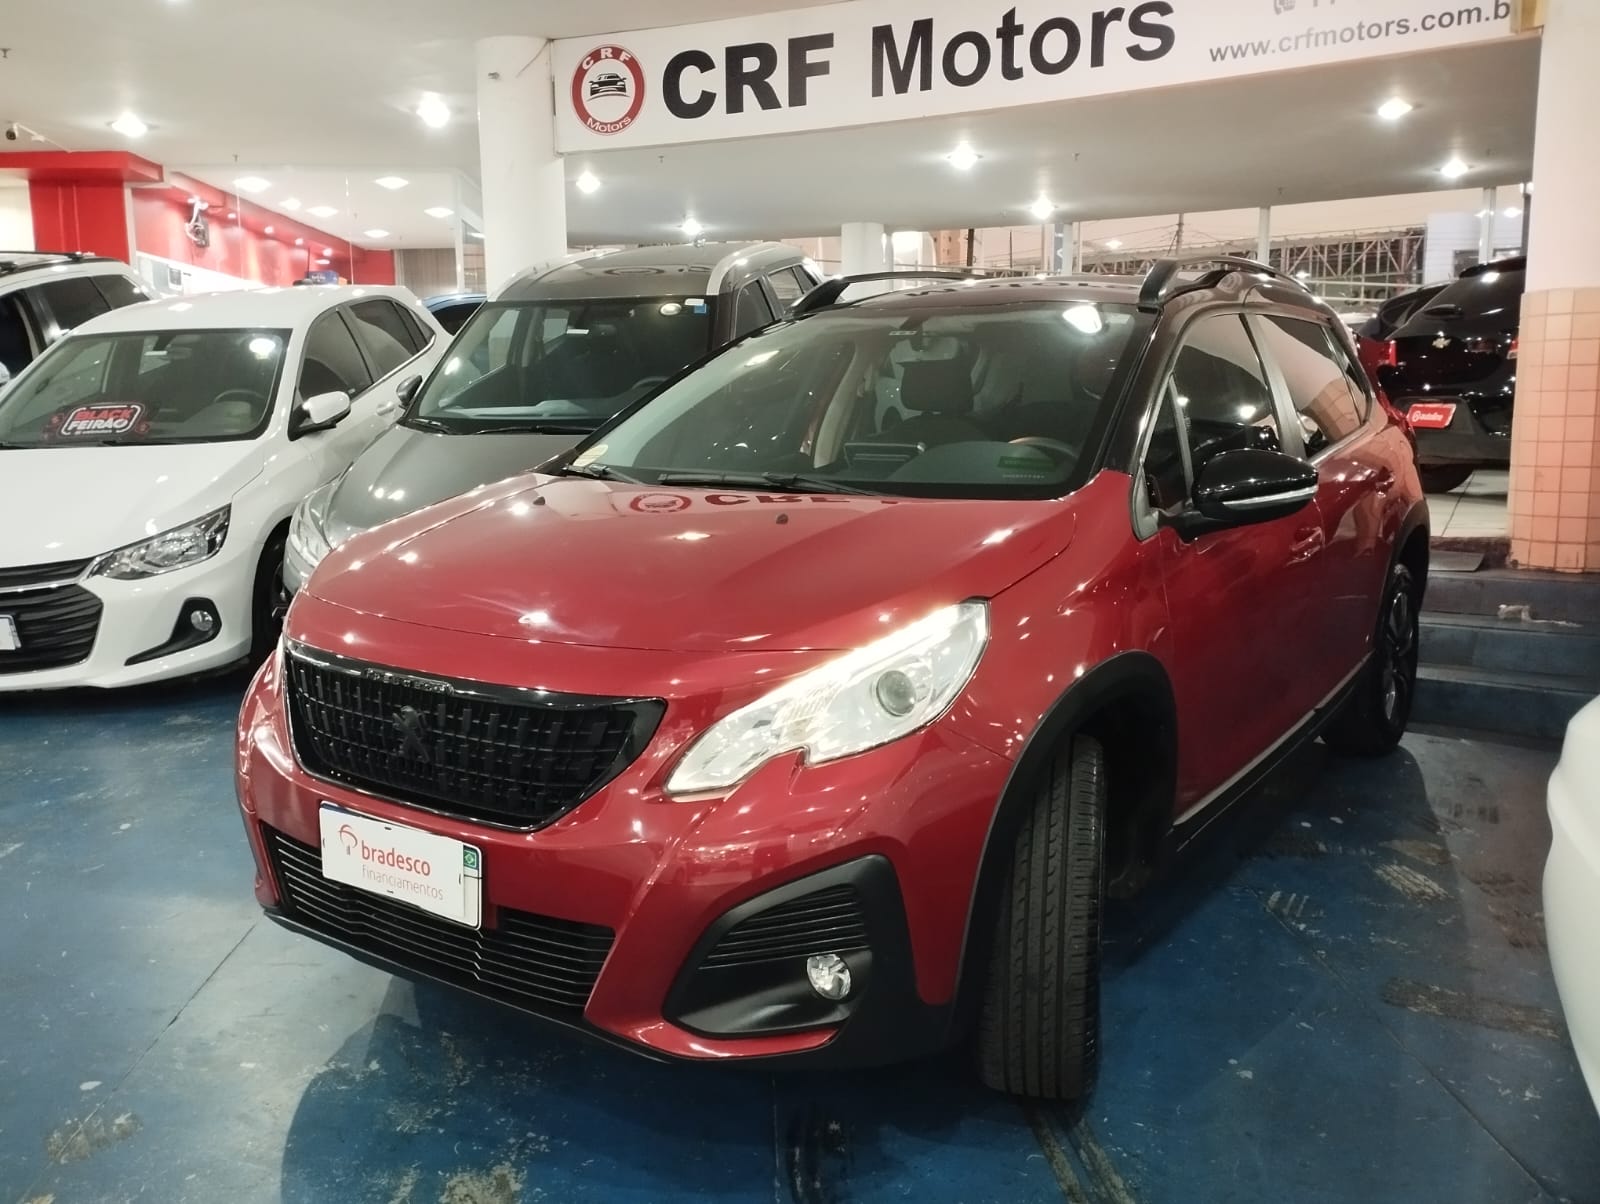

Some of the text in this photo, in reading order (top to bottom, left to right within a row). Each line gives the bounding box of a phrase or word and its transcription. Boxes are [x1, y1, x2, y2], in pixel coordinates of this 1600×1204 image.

[582, 47, 632, 70] CRF
[662, 0, 1176, 119] CRF Motors
[586, 116, 632, 132] Motors
[74, 408, 134, 420] BLACK
[361, 840, 431, 876] bradesco
